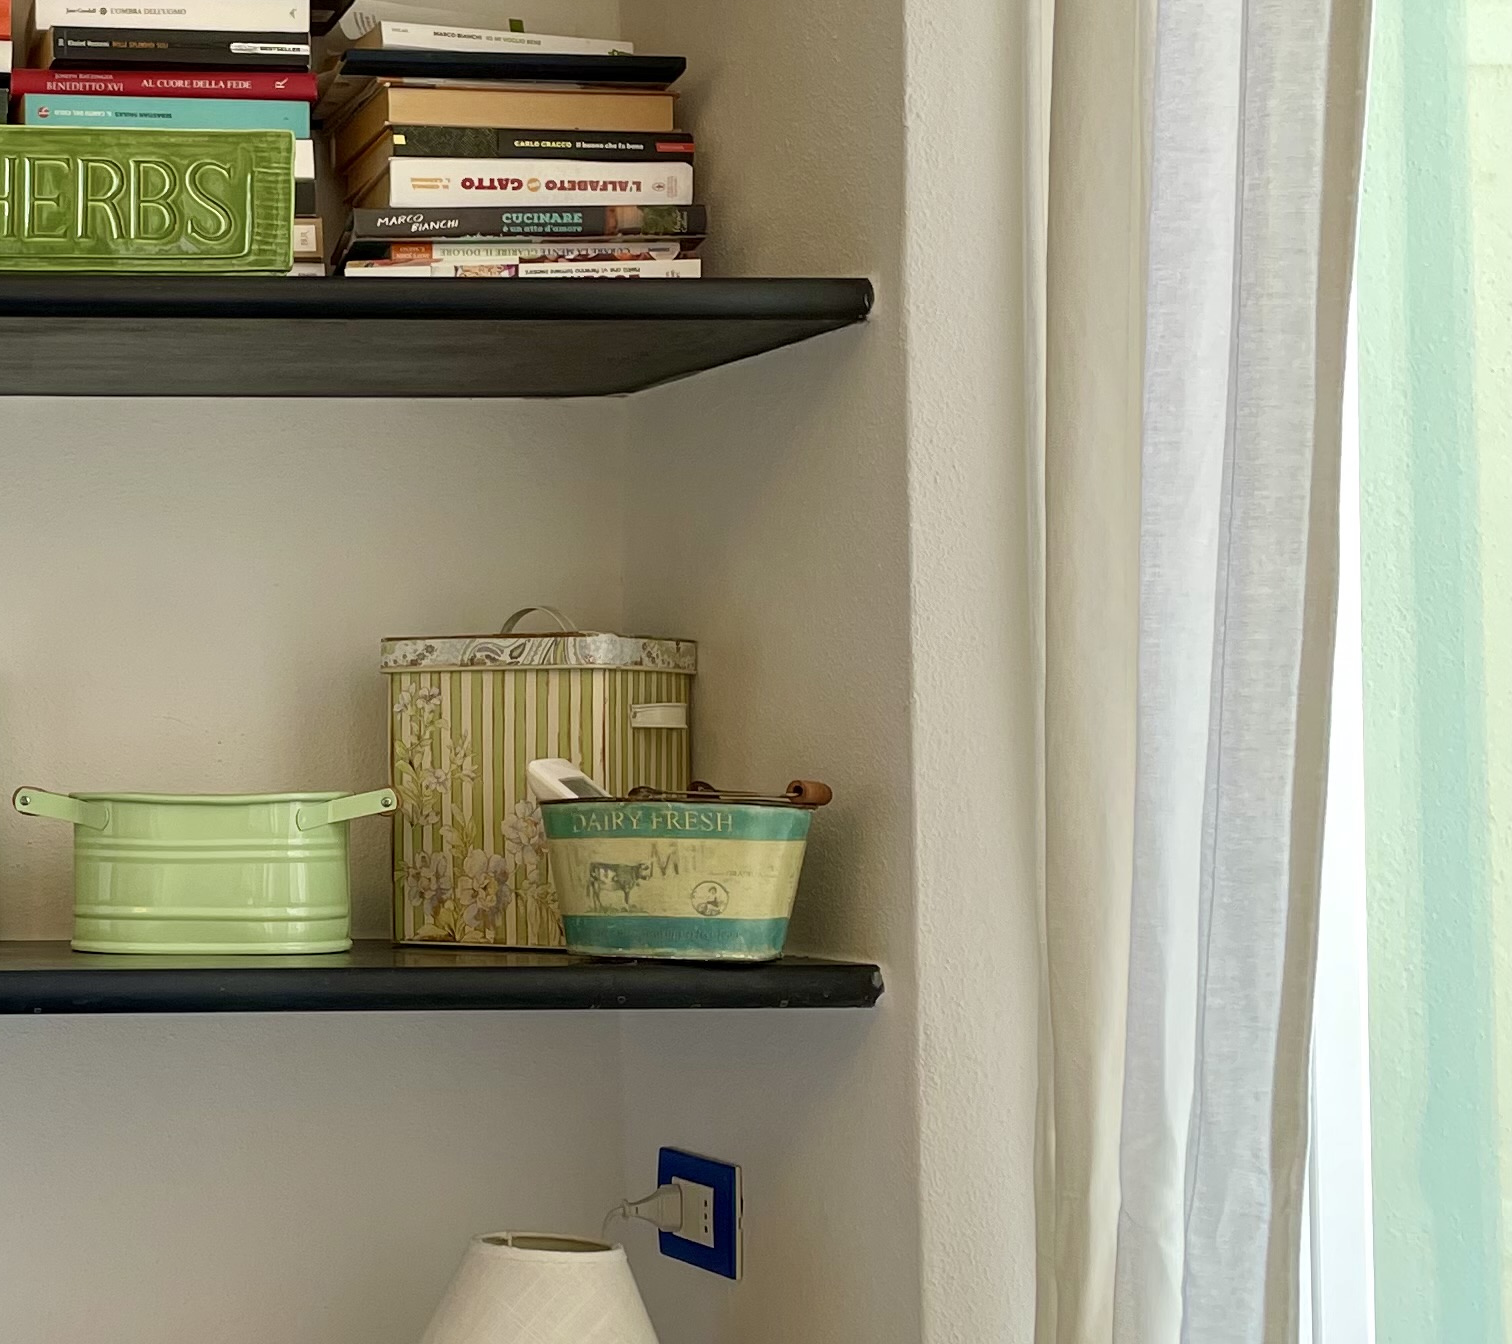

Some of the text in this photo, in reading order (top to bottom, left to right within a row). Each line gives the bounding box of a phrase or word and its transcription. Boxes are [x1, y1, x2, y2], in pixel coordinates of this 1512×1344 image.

[46, 81, 124, 92] BENEDETTO XVI
[141, 79, 252, 89] AL CUORE DELLA FEDE
[514, 140, 540, 148] CARLO
[460, 177, 524, 191] GATTO
[544, 179, 642, 192] L'ALFABETO
[376, 213, 424, 227] MARCO
[501, 212, 583, 225] CUCINARE
[410, 219, 459, 233] BIANCHI
[523, 225, 543, 233] atto
[544, 224, 583, 233] d'amore
[440, 246, 484, 256] DOLORE
[571, 811, 733, 833] DAIRY FRESH
